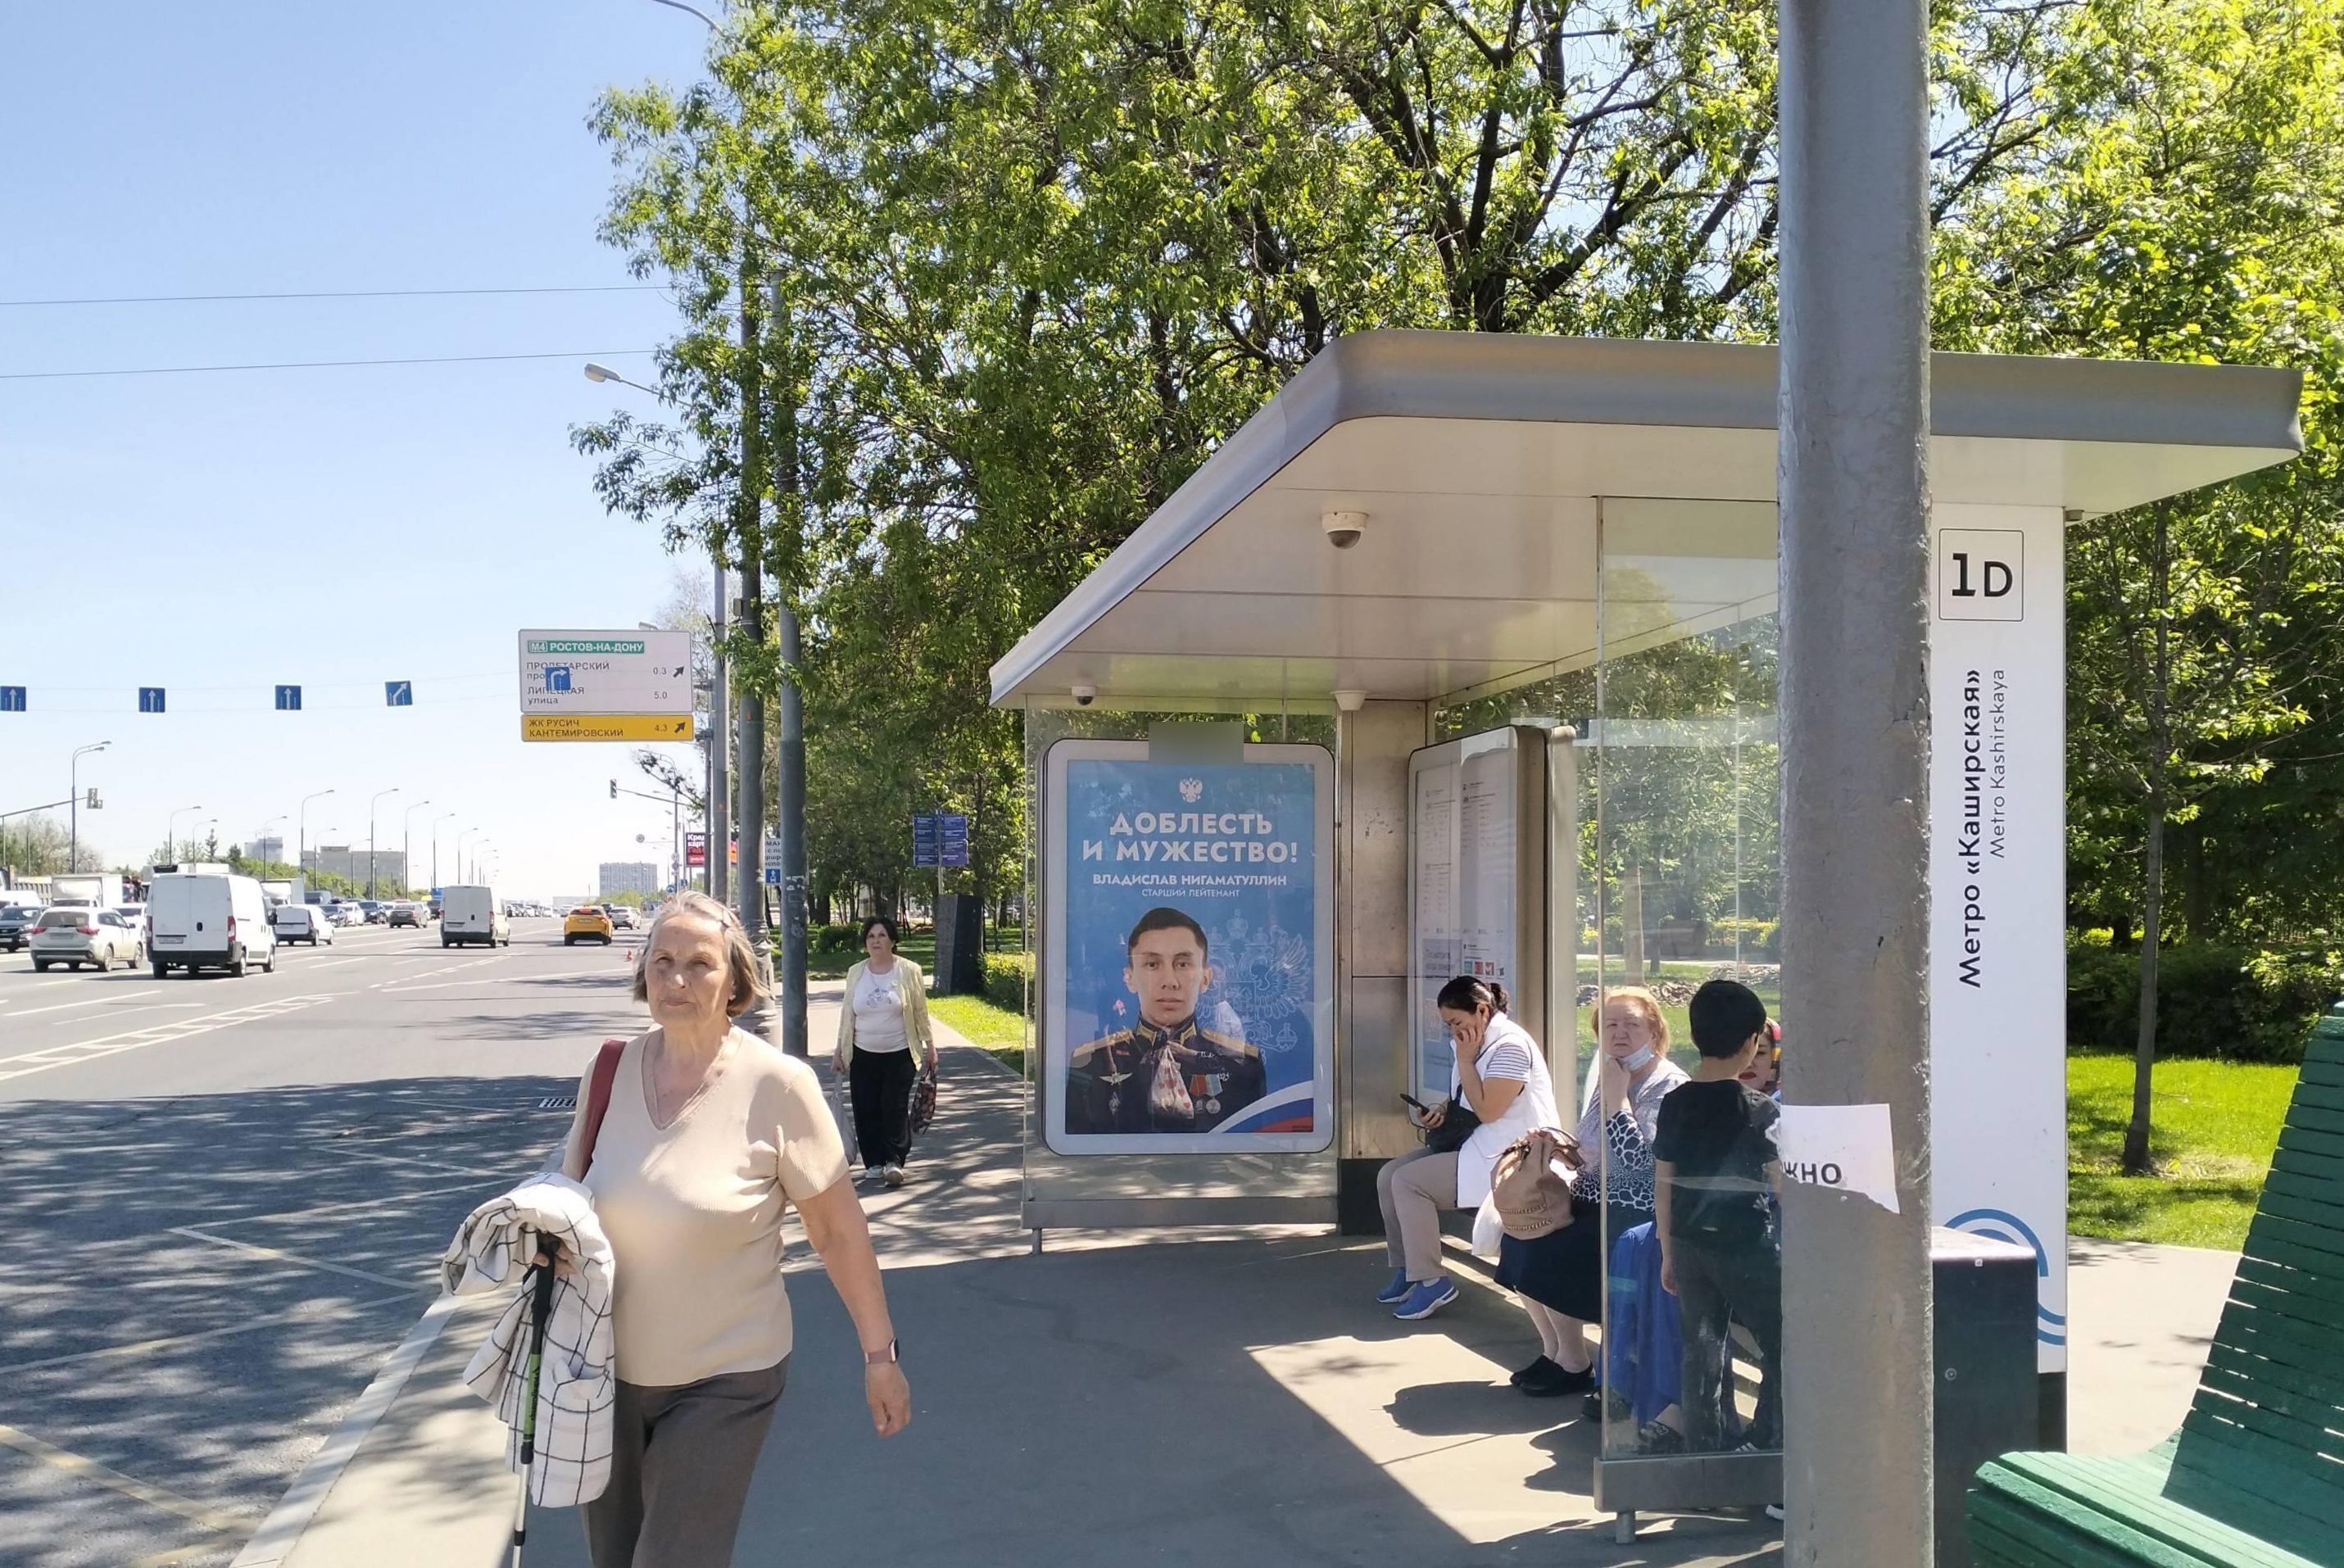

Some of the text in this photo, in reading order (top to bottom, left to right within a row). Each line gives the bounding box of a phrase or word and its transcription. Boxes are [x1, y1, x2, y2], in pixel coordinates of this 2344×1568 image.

[1952, 552, 2013, 598] 1D
[550, 642, 643, 653] РОСТОВ-НА-ДОНУ
[529, 728, 623, 737] КАНТЕМИРОВСКИЙ
[1990, 668, 2006, 859] Metro Kashirskaya
[1109, 812, 1272, 836] ДОБЛЕСТЬ
[1958, 668, 1986, 988] Метро «Каширская»
[1082, 840, 1298, 863] И МУЖЕСТВО!
[1093, 873, 1287, 886] ВЛАДИСЛАВ НИГАМАТУЛЛИН
[1141, 888, 1240, 898] СТАРШИЙ ЛЕЙТЕНАНТ
